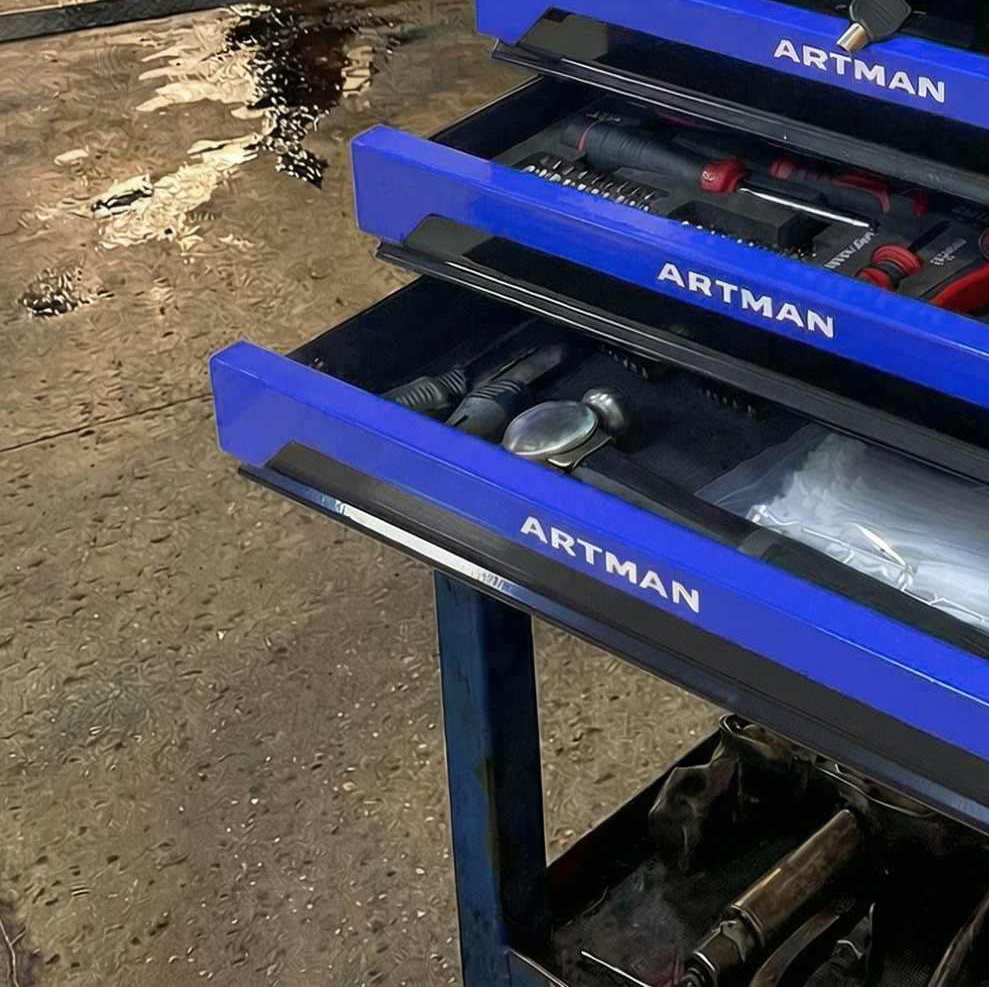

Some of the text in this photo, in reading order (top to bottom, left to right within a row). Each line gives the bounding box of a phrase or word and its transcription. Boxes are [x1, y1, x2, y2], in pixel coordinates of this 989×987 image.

[773, 39, 946, 104] ARTMAN
[657, 263, 835, 339] ARTMAN
[519, 516, 701, 614] ARTMAN
